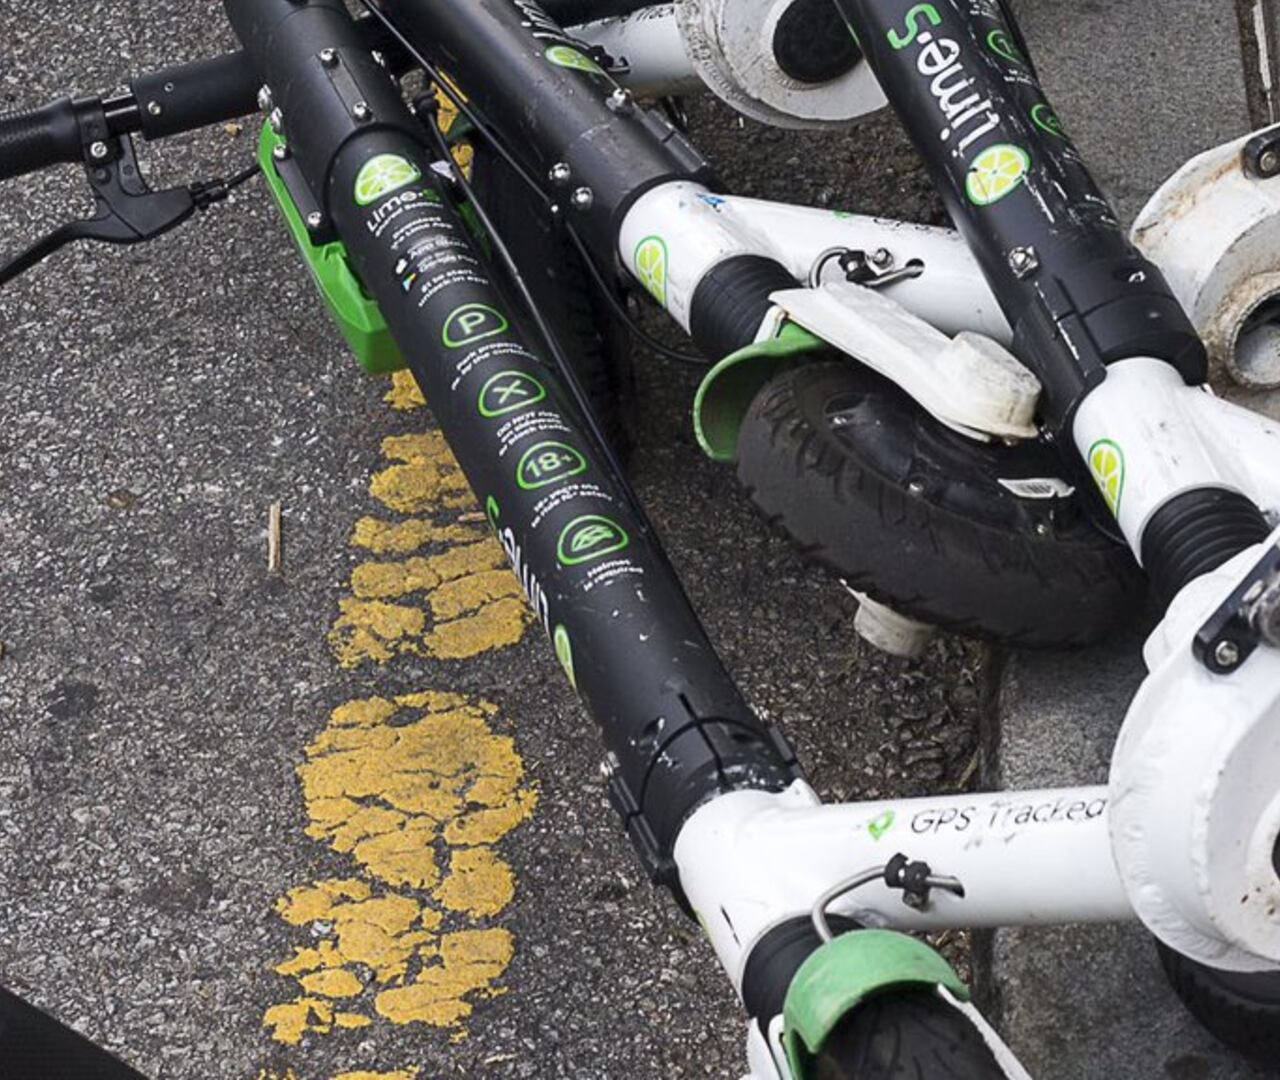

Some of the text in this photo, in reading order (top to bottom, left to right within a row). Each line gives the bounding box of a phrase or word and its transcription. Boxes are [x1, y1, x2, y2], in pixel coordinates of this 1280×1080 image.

[458, 311, 486, 336] P
[525, 451, 573, 479] 18+
[910, 805, 978, 835] GPS
